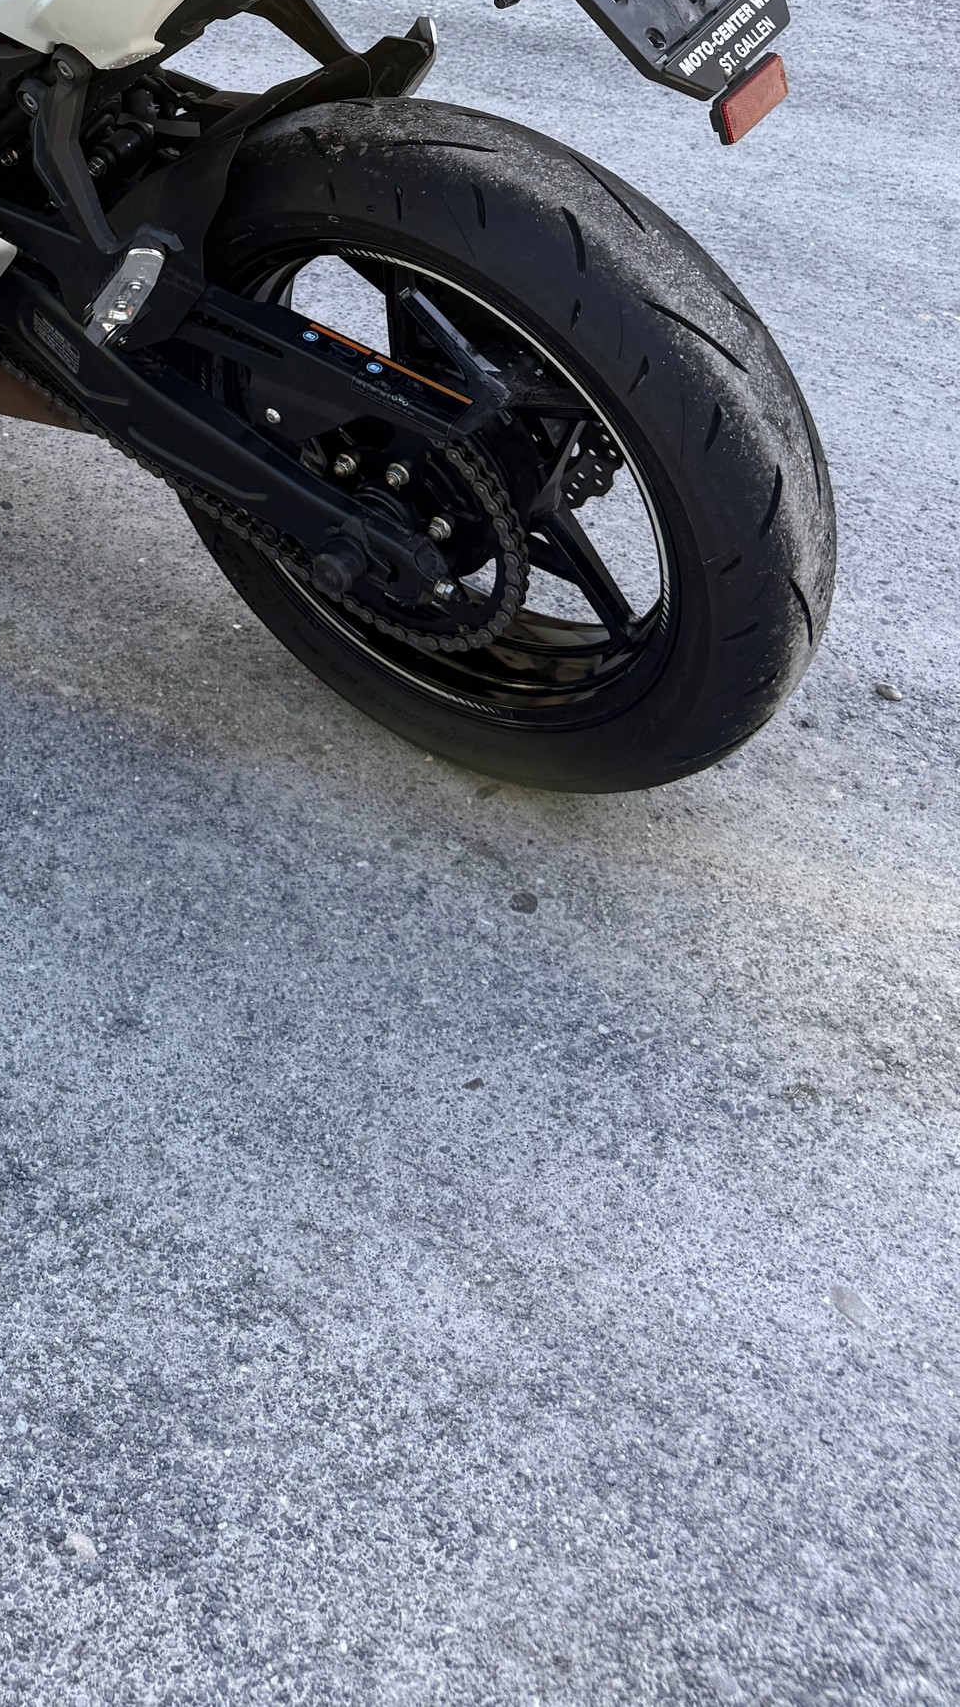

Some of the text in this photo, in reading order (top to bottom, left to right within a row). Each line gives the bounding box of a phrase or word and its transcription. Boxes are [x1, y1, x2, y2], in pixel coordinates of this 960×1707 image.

[678, 2, 756, 77] MOTO-CENTER
[718, 15, 777, 73] ST. GALLEN
